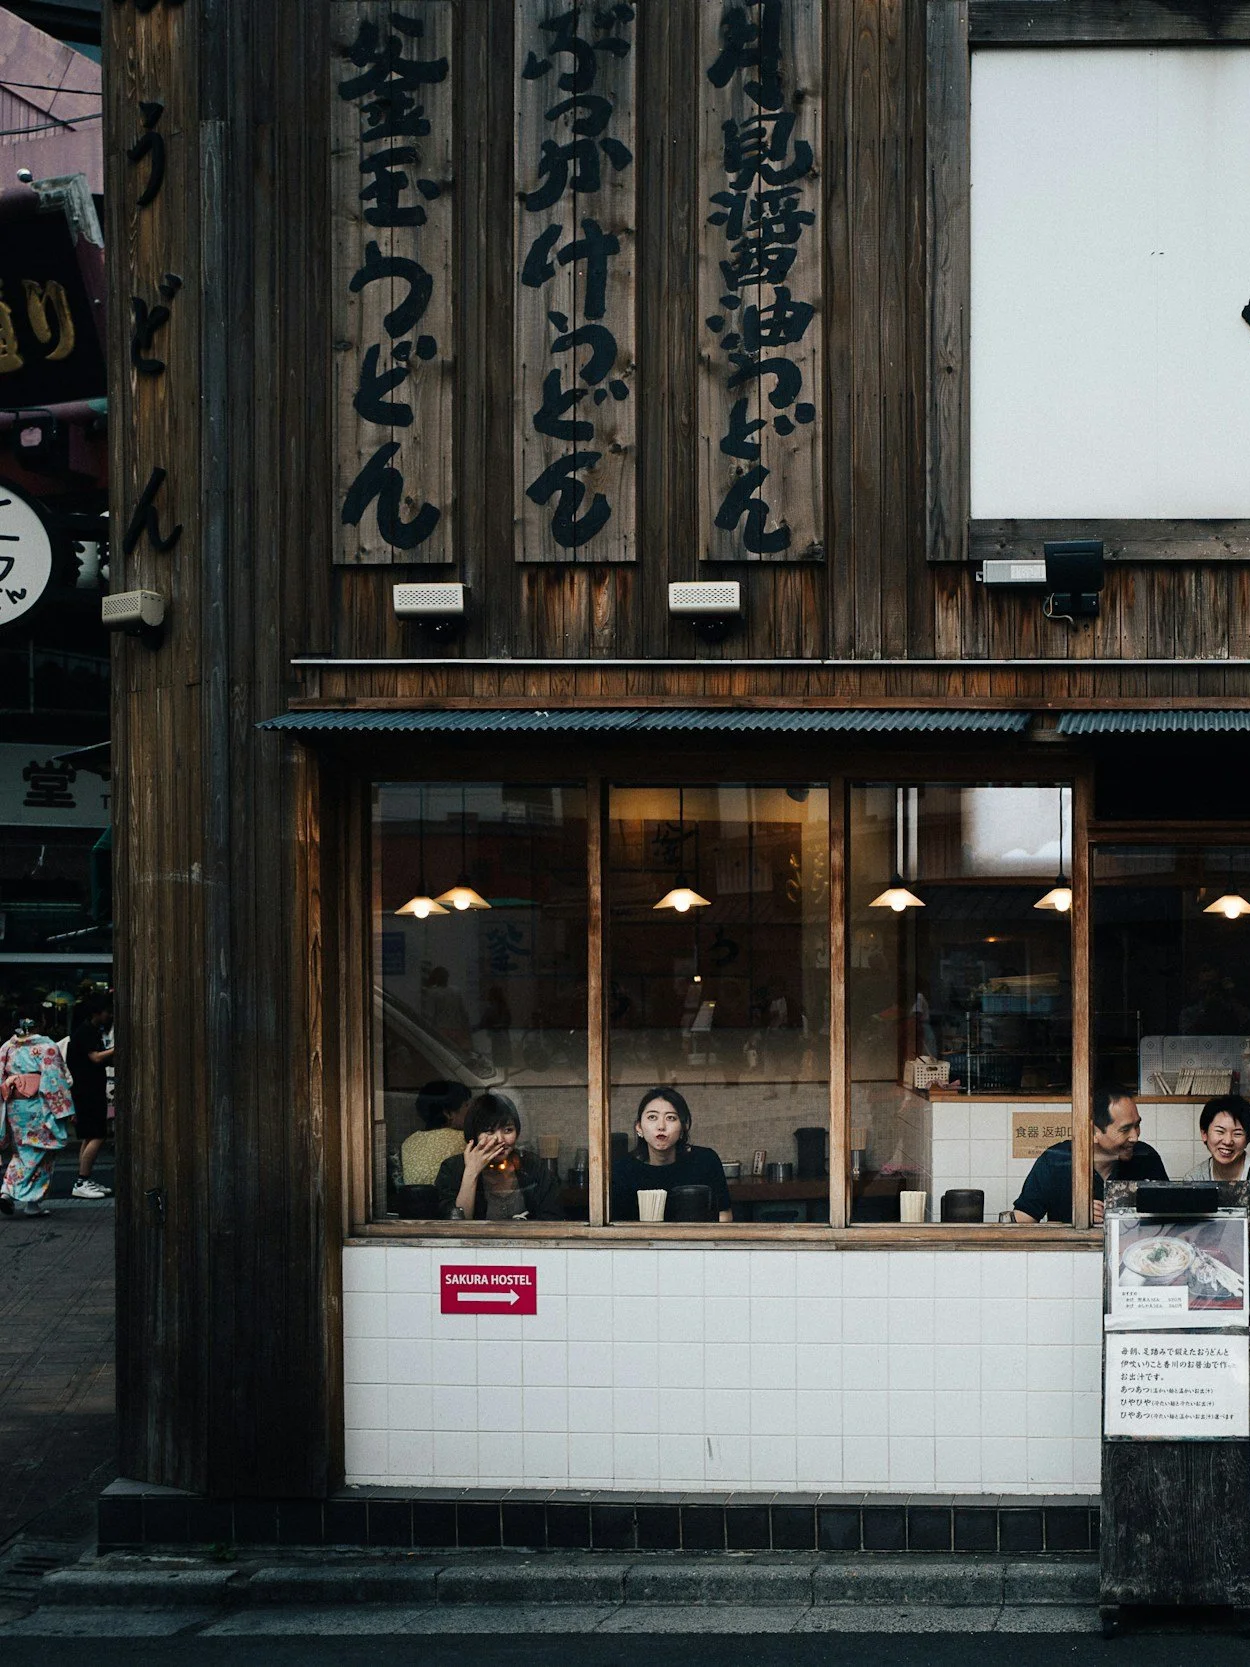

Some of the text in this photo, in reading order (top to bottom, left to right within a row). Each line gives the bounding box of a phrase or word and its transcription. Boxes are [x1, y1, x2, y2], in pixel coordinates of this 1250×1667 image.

[111, 0, 185, 556] うどん
[338, 12, 449, 551] 釜玉うどん
[520, 3, 634, 548] ぶっかけうどん
[23, 760, 77, 808] 堂
[1016, 1126, 1040, 1138] 食器
[445, 1274, 532, 1286] SAKURA HOSTEL
